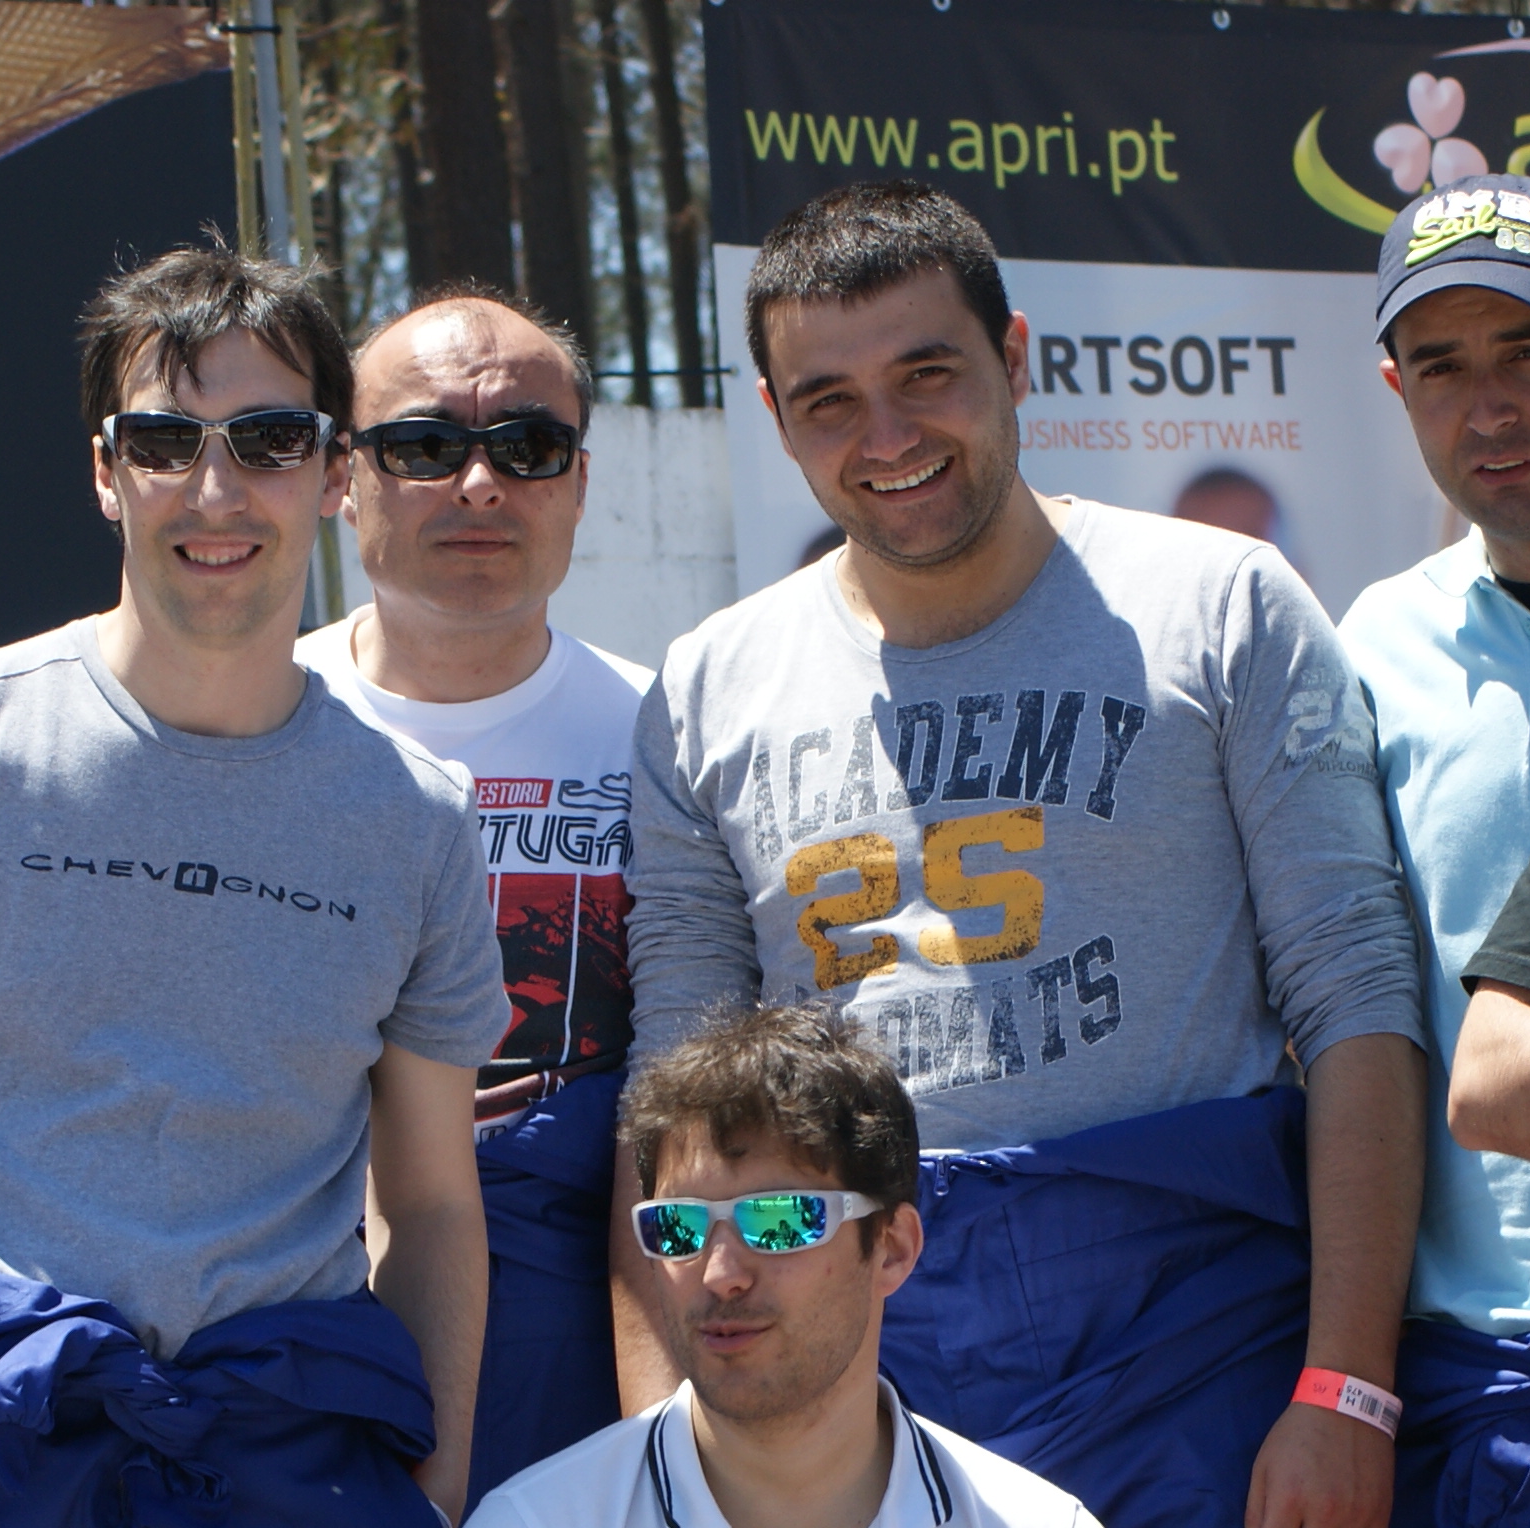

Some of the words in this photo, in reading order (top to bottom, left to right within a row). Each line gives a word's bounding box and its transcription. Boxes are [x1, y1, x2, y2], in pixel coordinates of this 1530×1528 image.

[744, 109, 1179, 195] www.apri.pt
[1030, 334, 1296, 396] RTSOFT
[1019, 420, 1132, 451] USINESS
[1141, 420, 1302, 451] SOFTWARE
[477, 781, 545, 806] ESTORIL
[751, 688, 1148, 869] ACADEMY
[479, 813, 634, 867] TUGA
[785, 805, 1045, 991] 25
